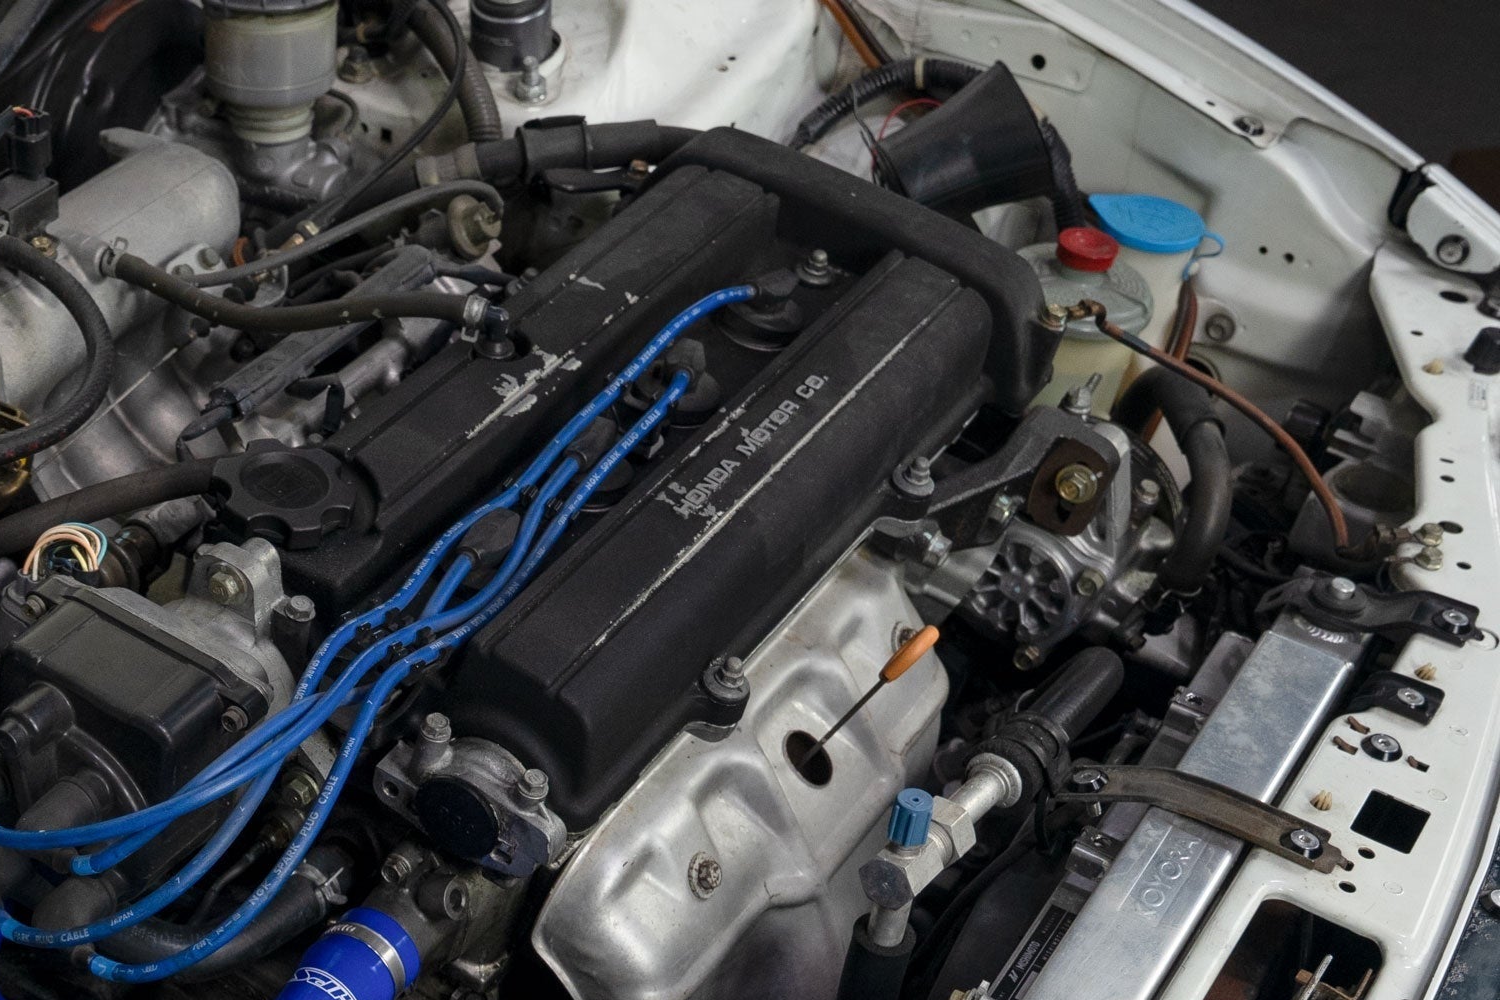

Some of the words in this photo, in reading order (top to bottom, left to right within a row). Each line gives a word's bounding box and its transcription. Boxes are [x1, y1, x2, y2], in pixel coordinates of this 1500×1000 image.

[640, 345, 658, 364] SPARK
[624, 363, 639, 379] PLUG
[605, 377, 624, 397] CABLE
[585, 473, 600, 490] NGK
[601, 450, 621, 472] SPARK
[621, 432, 639, 449] PLUG
[640, 408, 661, 430] CABLE
[672, 455, 741, 517] HONDA
[734, 398, 800, 456] MOTOR
[794, 369, 830, 399] CO.
[452, 625, 471, 639] CABLE
[470, 613, 487, 628] PLUG
[249, 880, 271, 907] NGK
[273, 843, 299, 876] SPARK
[299, 810, 320, 837] PLUG
[318, 775, 339, 805] CABLE
[342, 736, 356, 758] JAPAN
[60, 928, 90, 943] CABLE
[110, 910, 134, 927] JAPAN
[1014, 939, 1040, 970] MISHIMOTO
